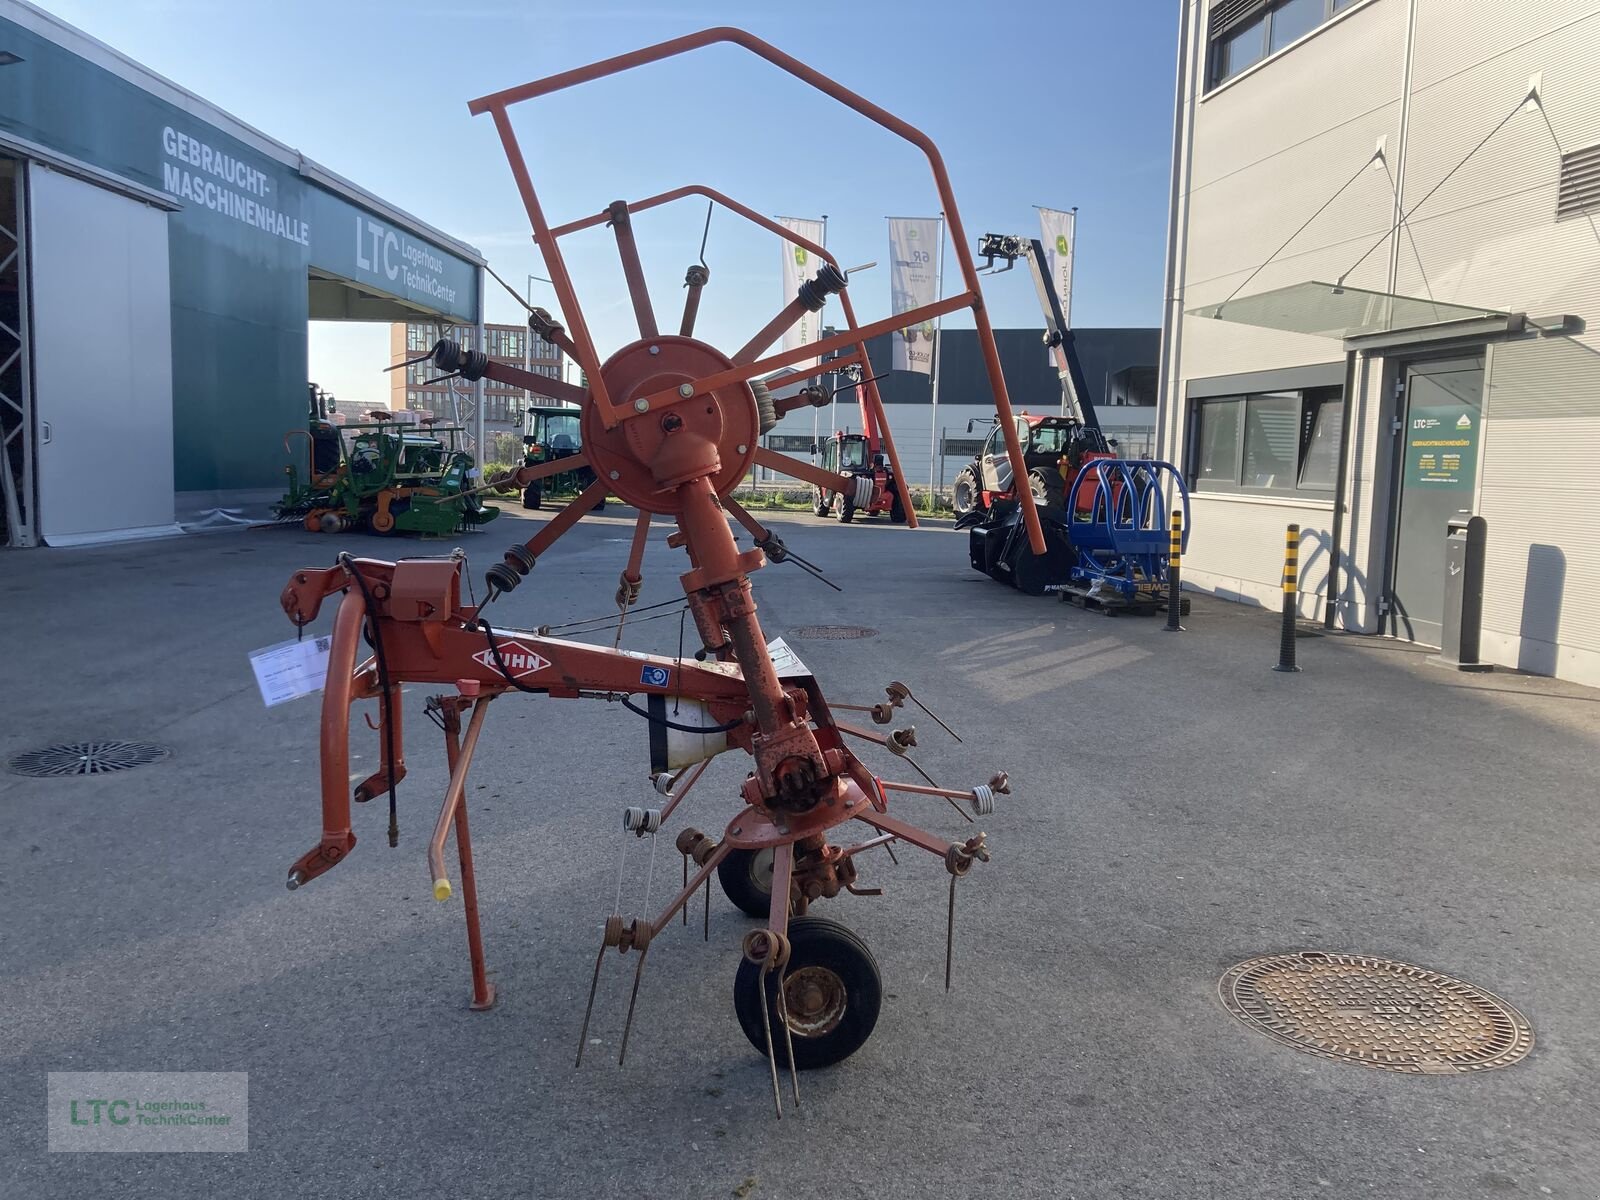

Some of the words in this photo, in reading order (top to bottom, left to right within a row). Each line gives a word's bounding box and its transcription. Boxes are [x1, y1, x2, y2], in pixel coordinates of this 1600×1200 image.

[162, 126, 271, 198] GEBRAUCHT-
[163, 162, 309, 246] MASCHINENHALLE
[356, 216, 399, 281] LTC
[401, 237, 443, 274] Lagerhaus
[401, 265, 456, 304] TechnikCenter
[1413, 419, 1426, 429] LTC
[483, 652, 540, 669] KUHN
